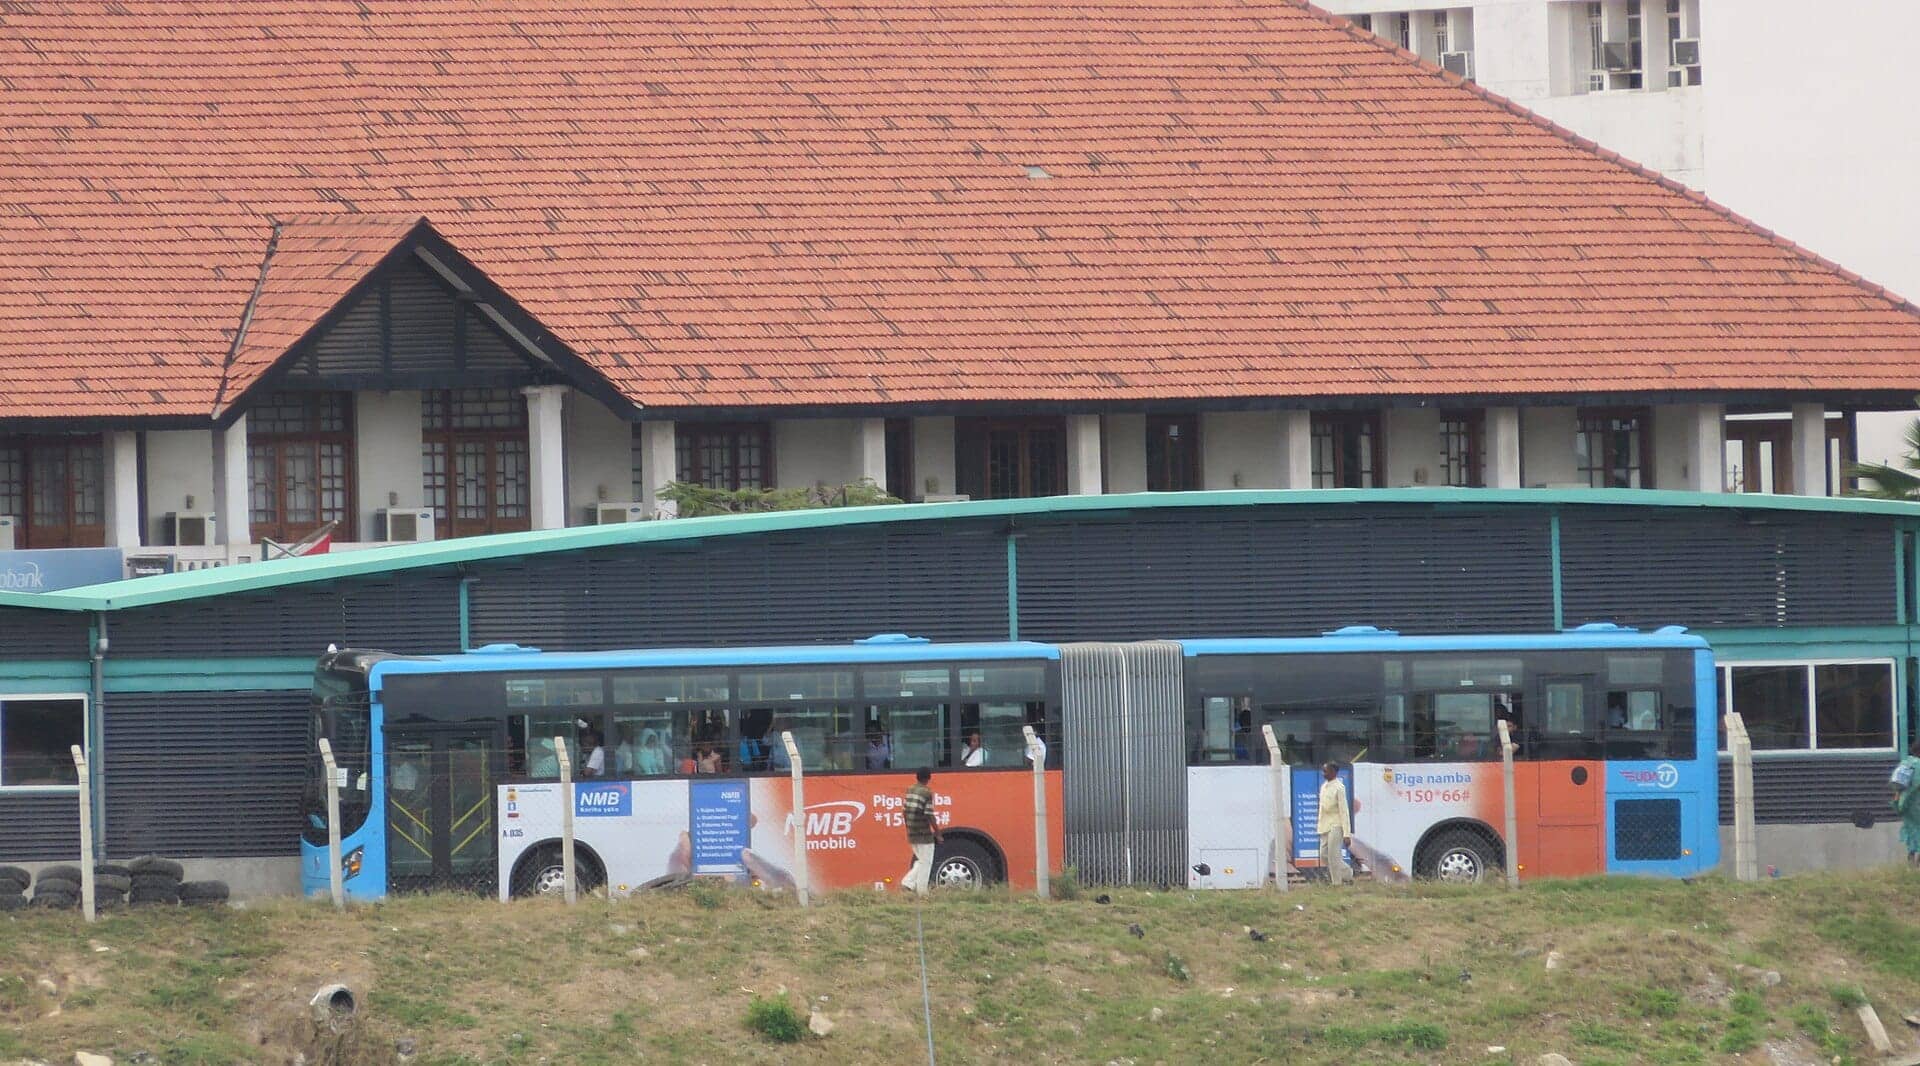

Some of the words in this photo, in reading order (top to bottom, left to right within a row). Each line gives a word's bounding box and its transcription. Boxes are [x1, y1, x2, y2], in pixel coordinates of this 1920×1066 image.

[1395, 773, 1423, 787] Piga
[1427, 772, 1472, 783] namba
[580, 791, 620, 806] NMB
[873, 794, 903, 809] Piga
[806, 836, 856, 849] mobile
